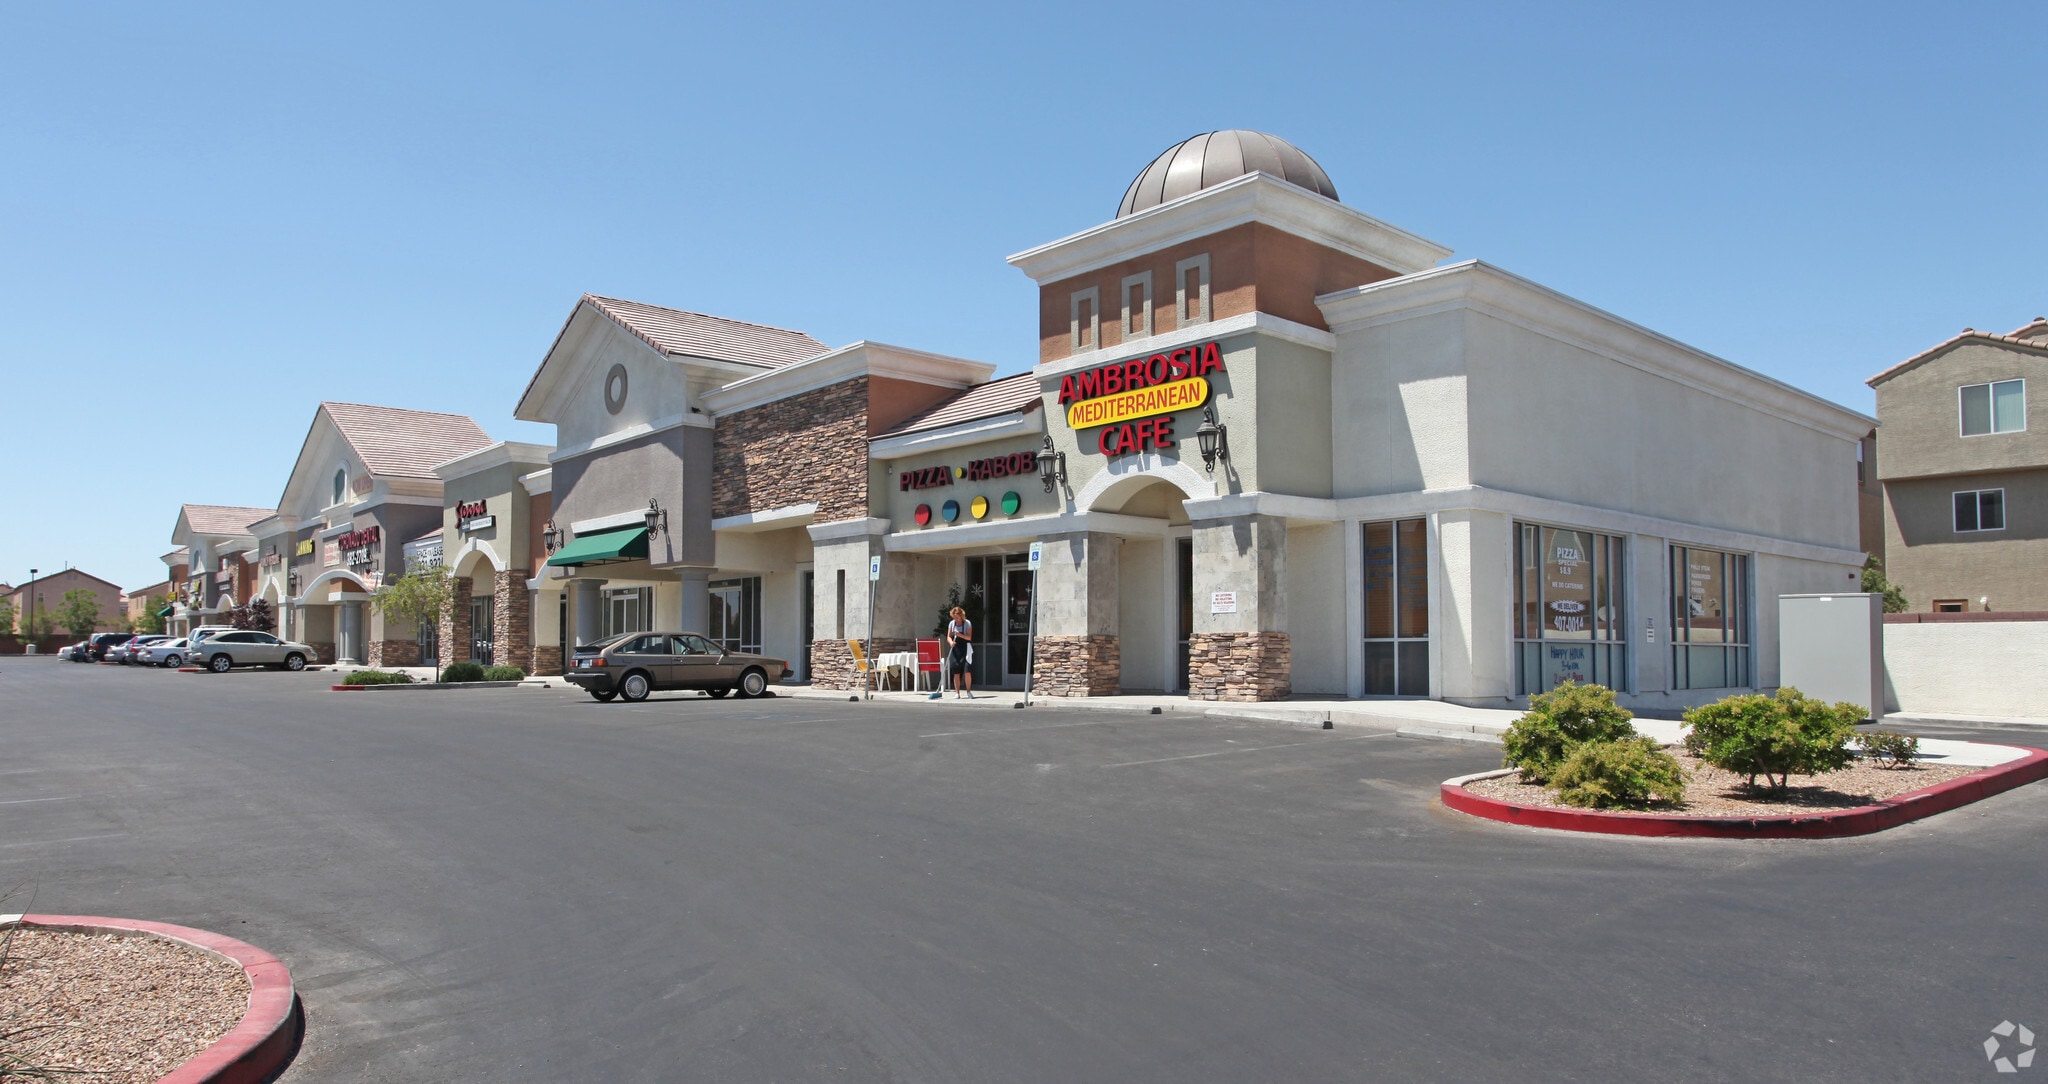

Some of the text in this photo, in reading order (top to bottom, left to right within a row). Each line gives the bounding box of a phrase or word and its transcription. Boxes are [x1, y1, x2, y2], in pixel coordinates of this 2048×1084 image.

[1058, 342, 1223, 404] AMBROSIA
[1073, 381, 1200, 425] MEDITERRANEAN
[1098, 417, 1171, 456] CAFE
[900, 451, 1037, 491] PIZZA KABOB
[1556, 547, 1579, 560] PIZZA
[1565, 582, 1584, 590] CATERING
[1563, 603, 1579, 611] DELIVER
[1554, 615, 1584, 632] 407-0014
